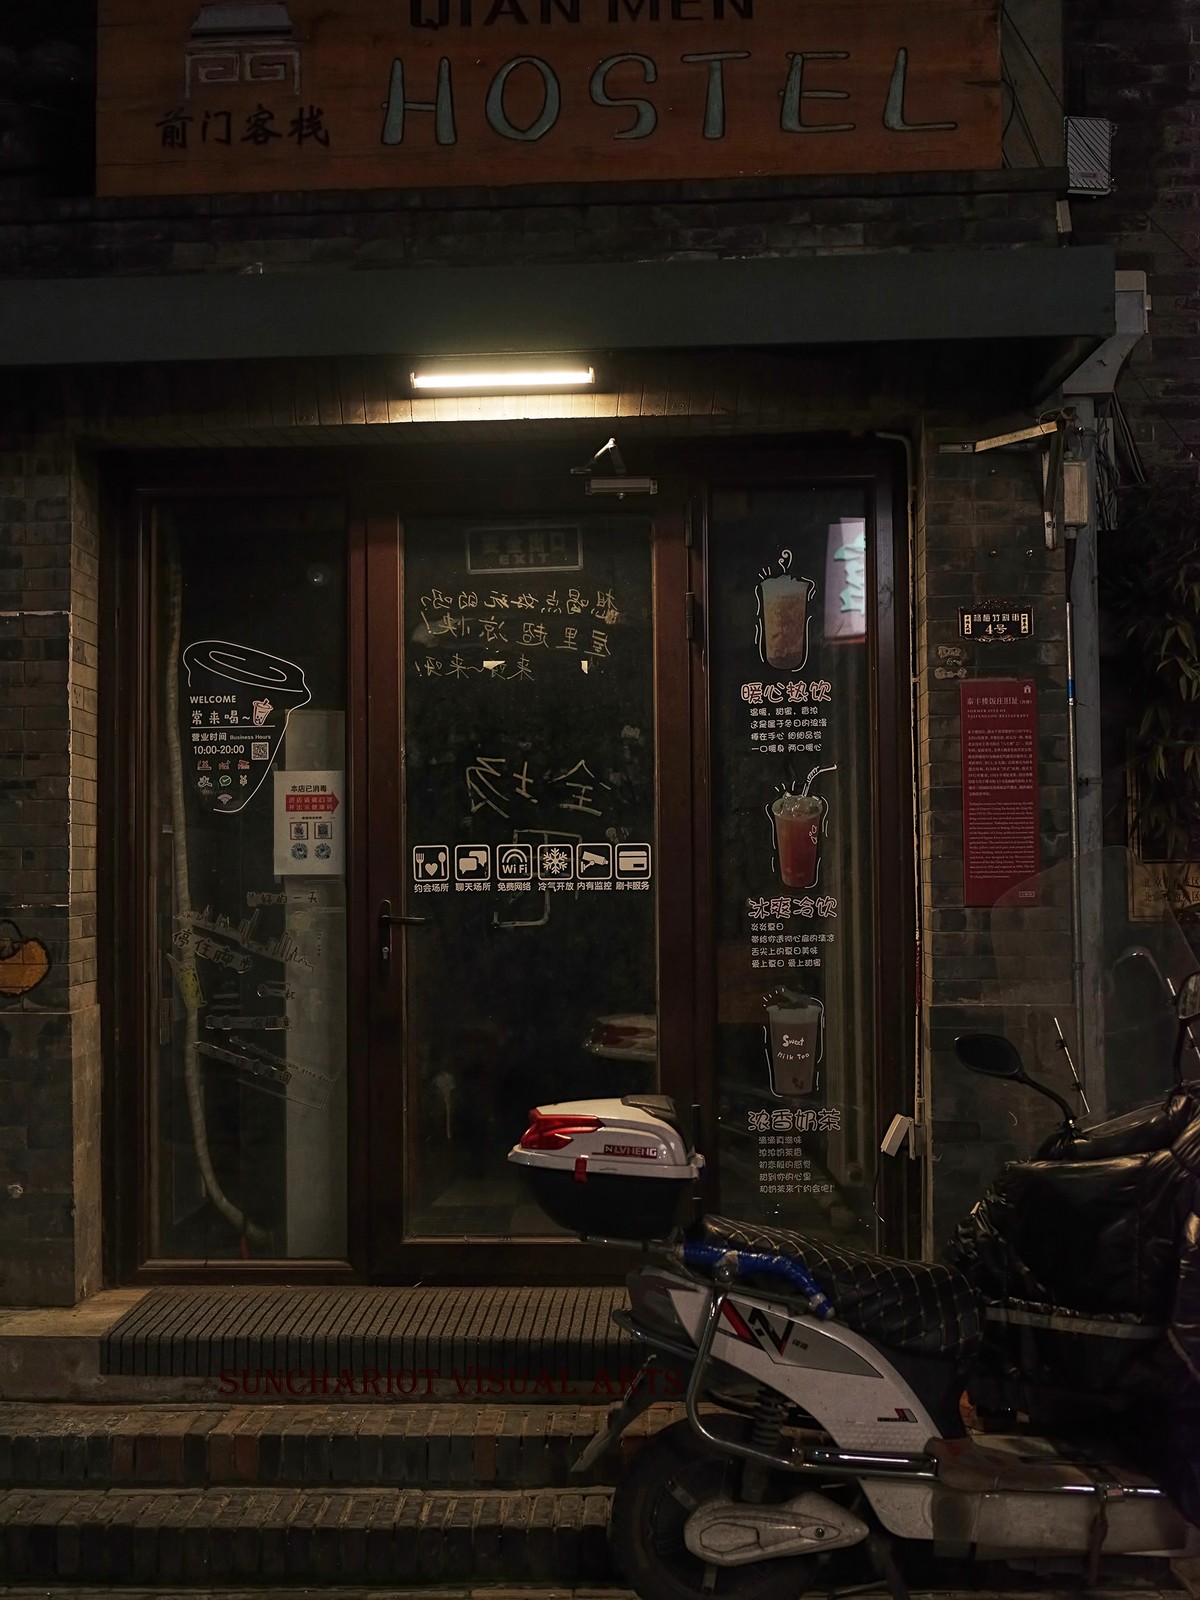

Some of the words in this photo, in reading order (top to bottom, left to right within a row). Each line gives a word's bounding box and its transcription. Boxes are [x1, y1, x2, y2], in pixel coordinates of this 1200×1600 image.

[410, 0, 580, 30] QIAN
[607, 0, 753, 24] MEN
[381, 47, 957, 146] HOSTEL
[155, 103, 330, 149] 前门客栈
[500, 552, 549, 566] EXIT
[741, 679, 831, 704] 暖心热饮
[189, 694, 237, 705] WELCOME
[191, 732, 227, 743] 营业时间
[255, 733, 271, 741] Hours
[193, 744, 245, 755] 10:00-20:00
[751, 744, 785, 753] 一口暖身
[787, 743, 822, 753] 两口暖心
[290, 785, 328, 793] 本店已消毒
[413, 883, 450, 894] 约会场所
[454, 881, 492, 893] 聊天场所
[497, 881, 532, 892] 免费网络
[538, 881, 575, 893] 冷气开放
[577, 881, 613, 892] 内有监控
[615, 881, 650, 892] 刷卡服务
[747, 896, 838, 919] 冰爽冷饮
[751, 946, 818, 956] 舌尖上的夏日美味
[782, 1034, 805, 1048] Sweet
[747, 1107, 841, 1132] 浓香奶茶
